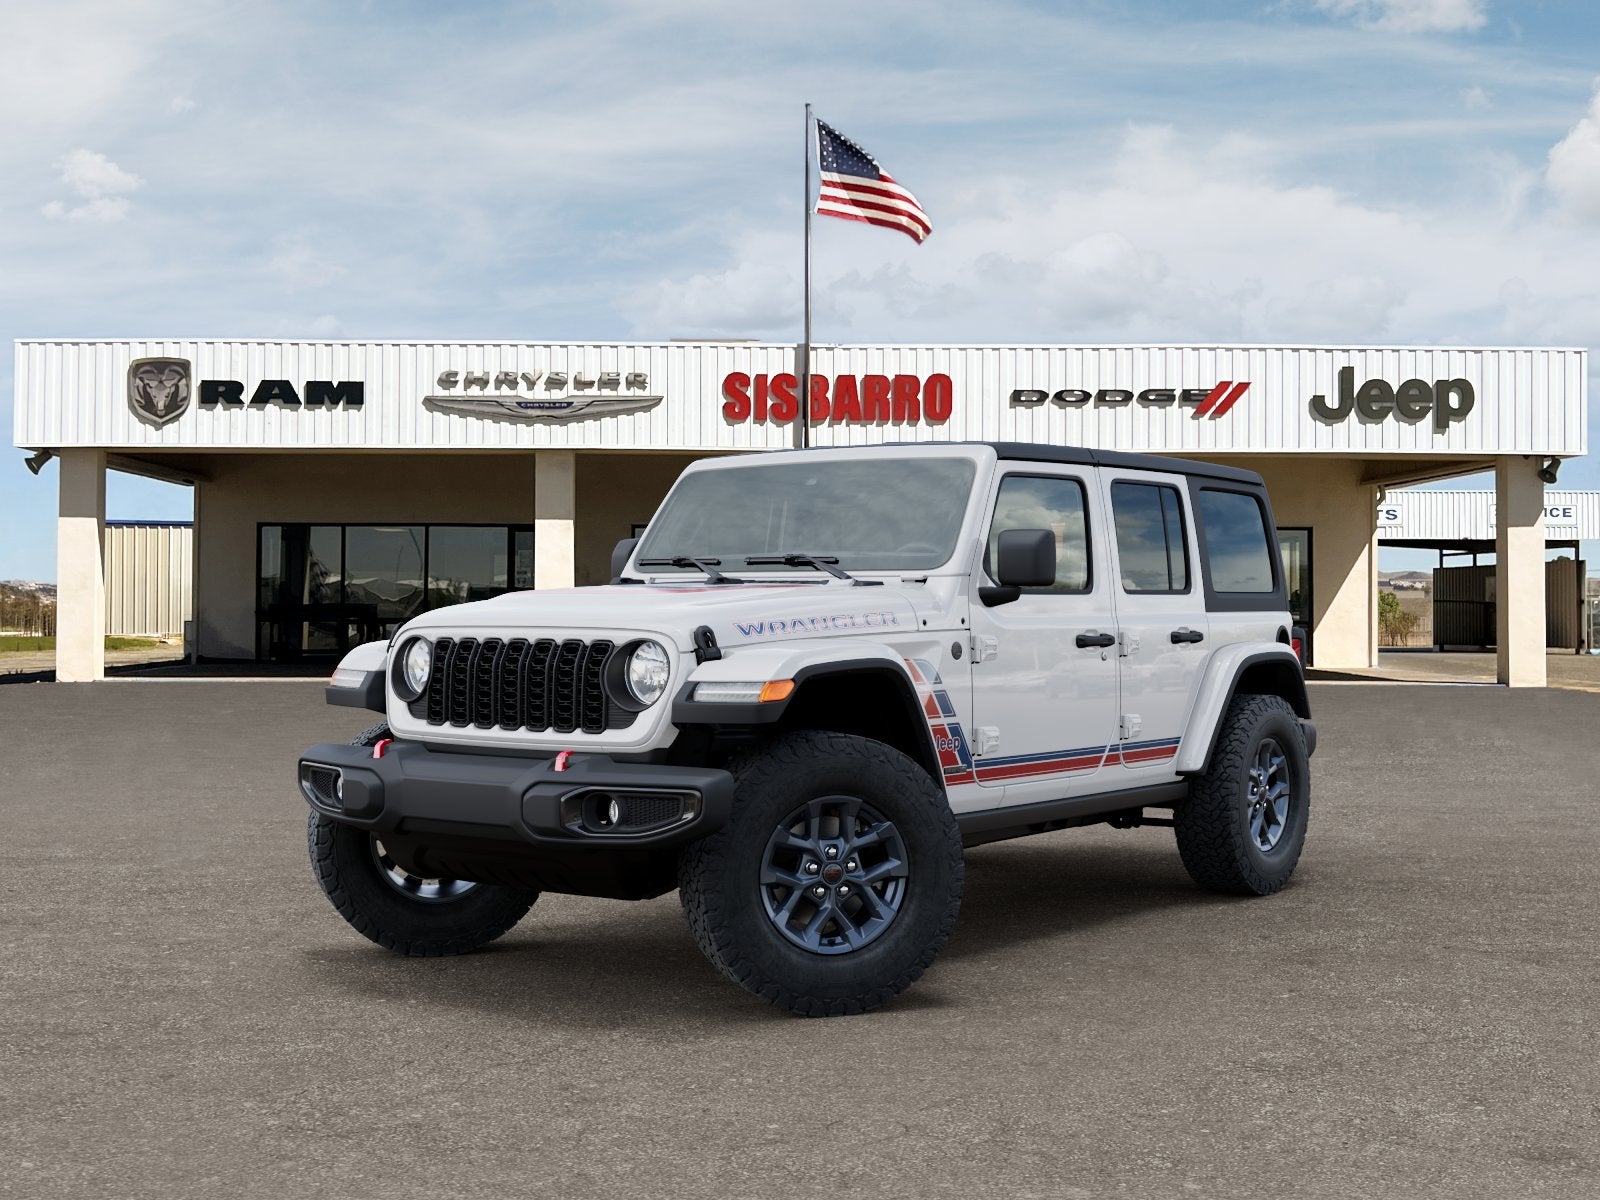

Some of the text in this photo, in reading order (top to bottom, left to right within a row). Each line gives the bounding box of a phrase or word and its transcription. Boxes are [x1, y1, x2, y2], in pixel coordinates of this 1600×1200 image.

[438, 369, 649, 388] CHRYSLER
[200, 379, 365, 407] RAM
[722, 371, 953, 423] SISBARRO
[1011, 388, 1214, 404] DODGE
[1311, 365, 1475, 430] Jeep
[734, 611, 900, 637] WRANGLER
